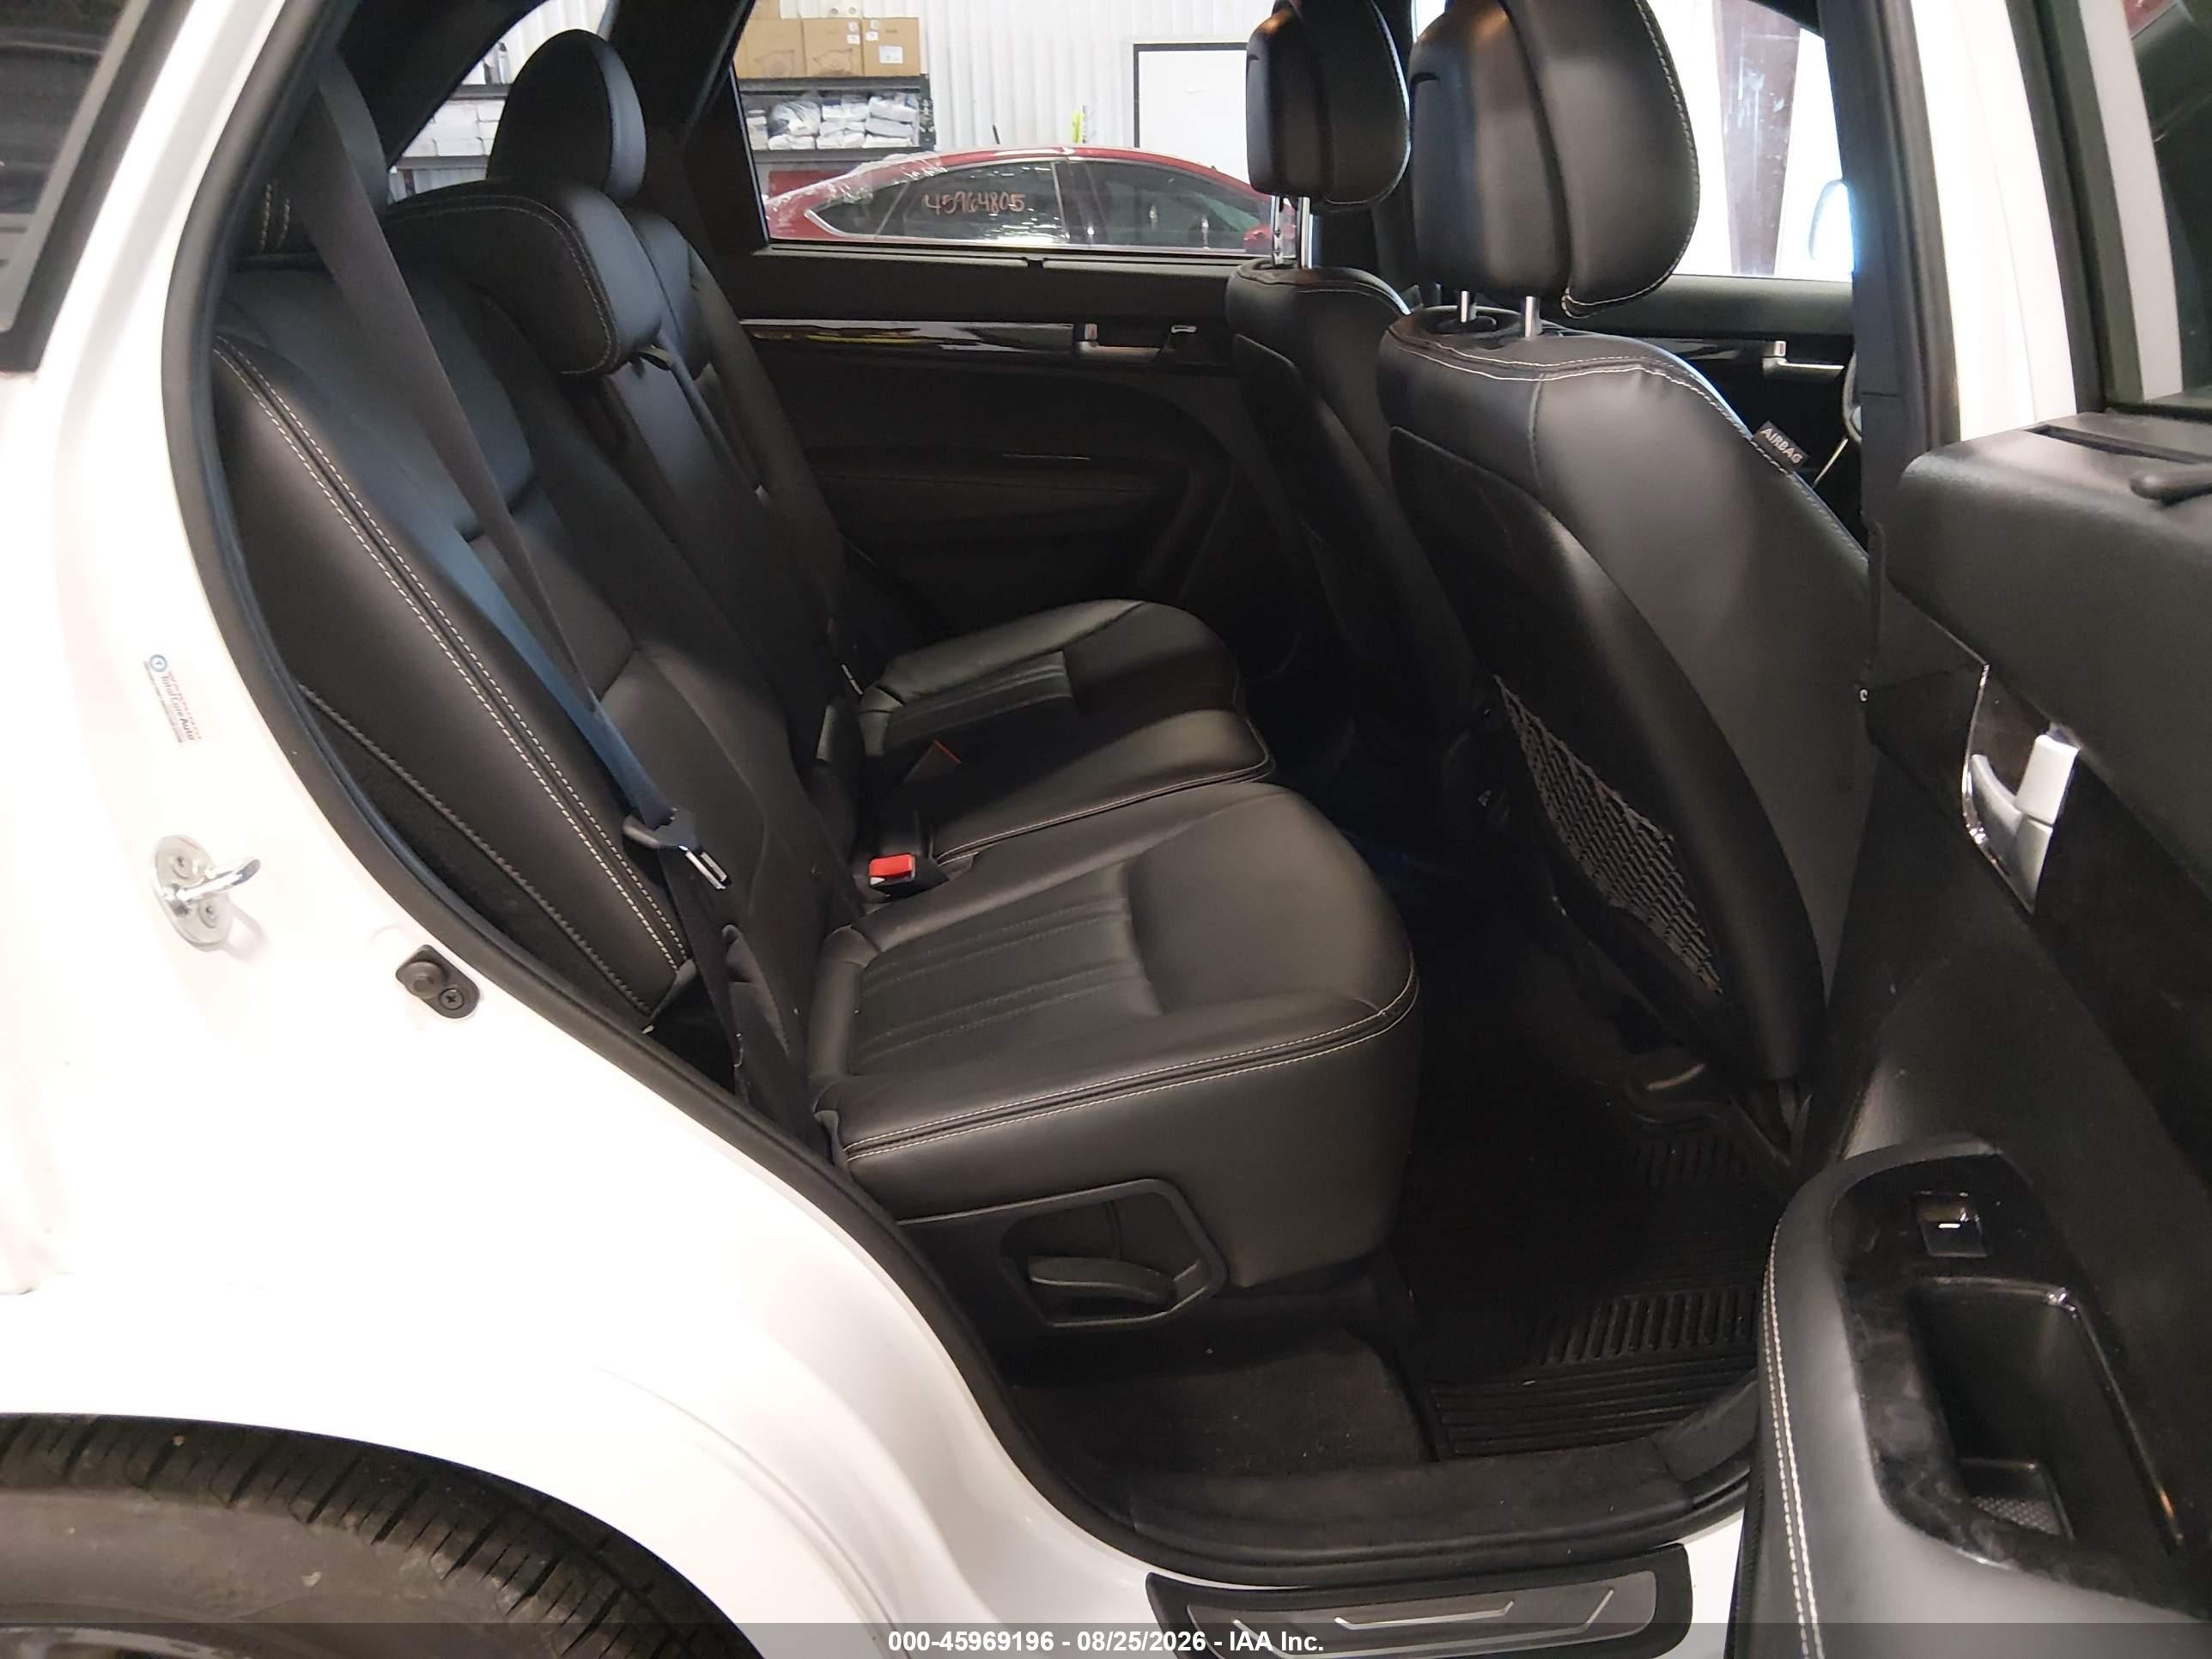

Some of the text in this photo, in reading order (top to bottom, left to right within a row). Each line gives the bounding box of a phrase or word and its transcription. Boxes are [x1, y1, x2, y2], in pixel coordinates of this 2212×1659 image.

[924, 191, 1026, 216] 45964805
[1759, 428, 1803, 464] AIRBAG
[179, 718, 195, 740] Auto
